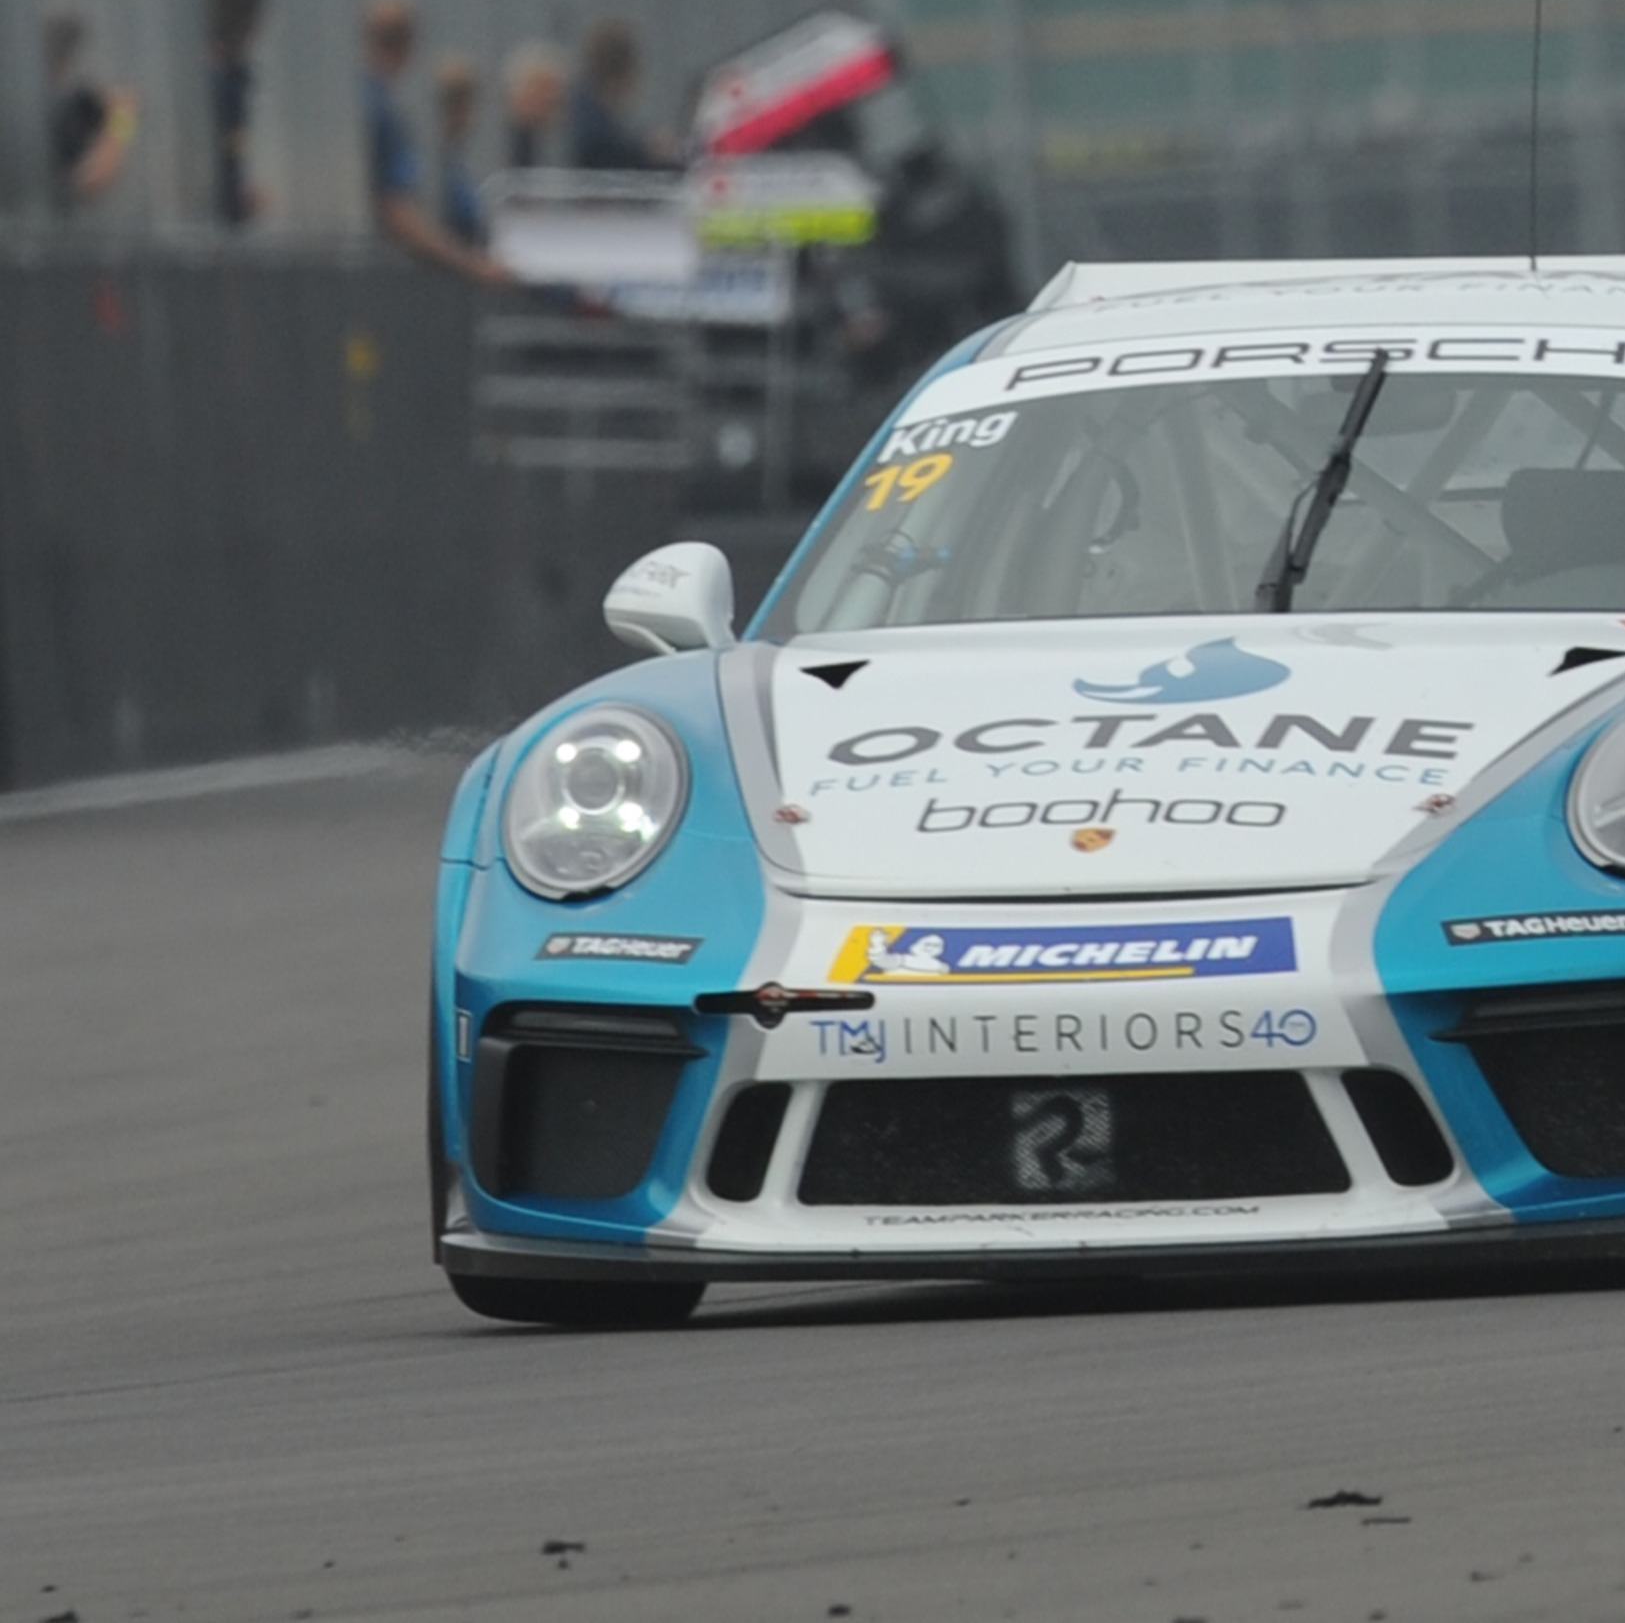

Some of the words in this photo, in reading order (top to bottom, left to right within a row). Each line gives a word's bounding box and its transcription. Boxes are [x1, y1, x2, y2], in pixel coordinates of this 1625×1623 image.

[876, 411, 1018, 464] King
[864, 454, 953, 510] 19
[826, 713, 1476, 766] OCTANE
[808, 768, 949, 797] FUEL
[986, 756, 1148, 780] YOUR
[1178, 755, 1450, 788] FINANCE
[916, 788, 1288, 834] boohoo
[957, 934, 1258, 969] MICHELIN
